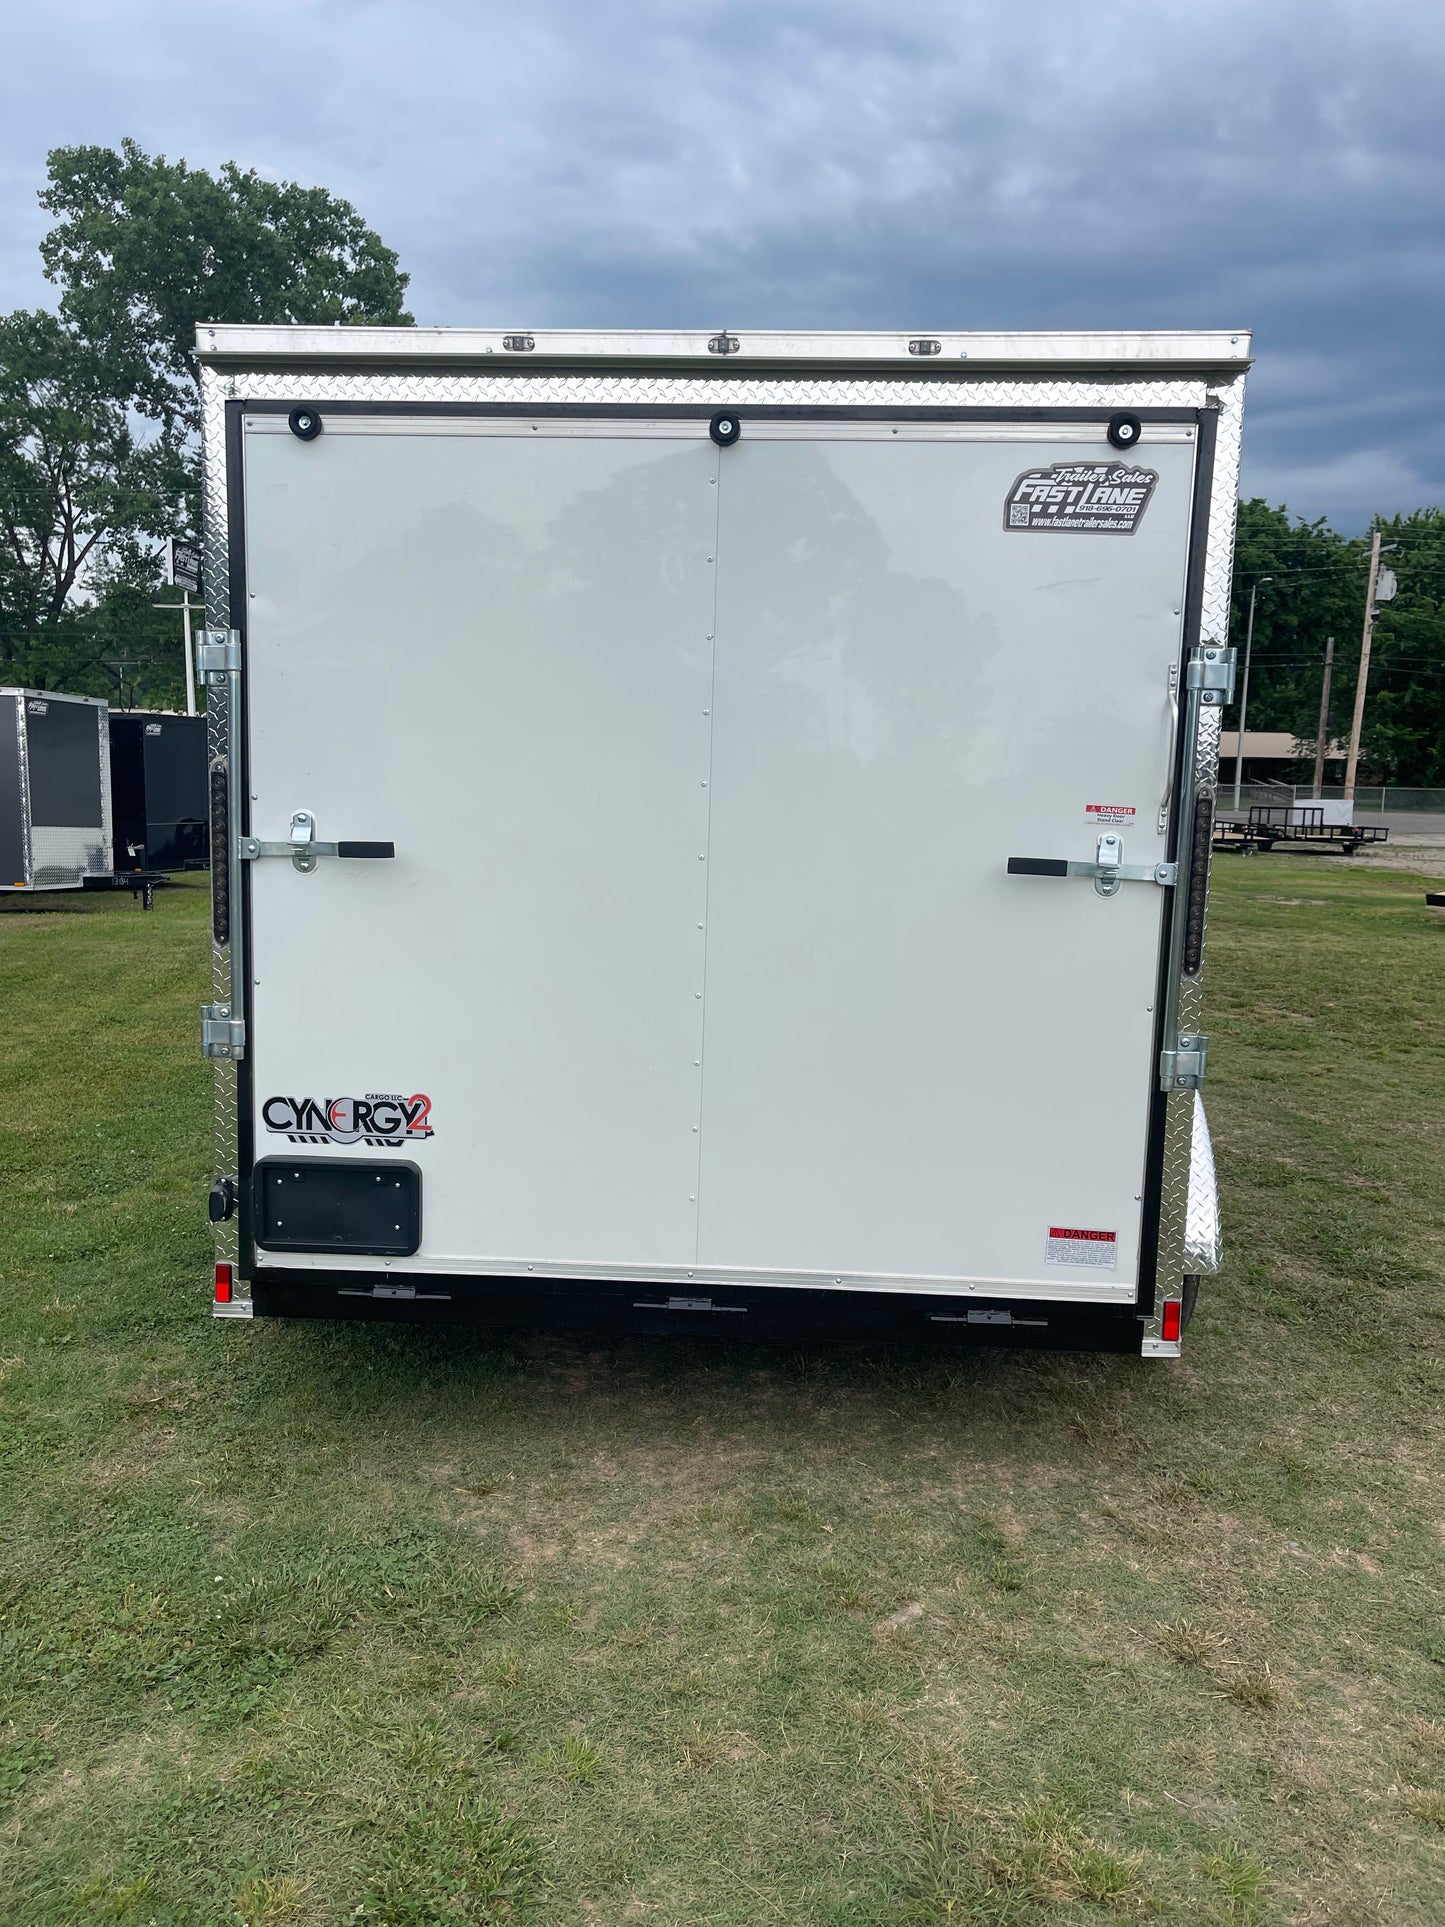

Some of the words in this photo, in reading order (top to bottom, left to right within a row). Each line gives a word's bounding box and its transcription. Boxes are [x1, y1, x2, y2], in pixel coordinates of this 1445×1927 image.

[1056, 468, 1107, 483] Trailer
[1110, 469, 1153, 485] Sales
[1079, 505, 1136, 513] 918-696-0701
[1031, 516, 1133, 529] www.fastlanetrailersales.com
[1100, 806, 1133, 814] DANGER
[365, 1093, 390, 1101] CARGO
[1063, 1229, 1115, 1242] DANGER
